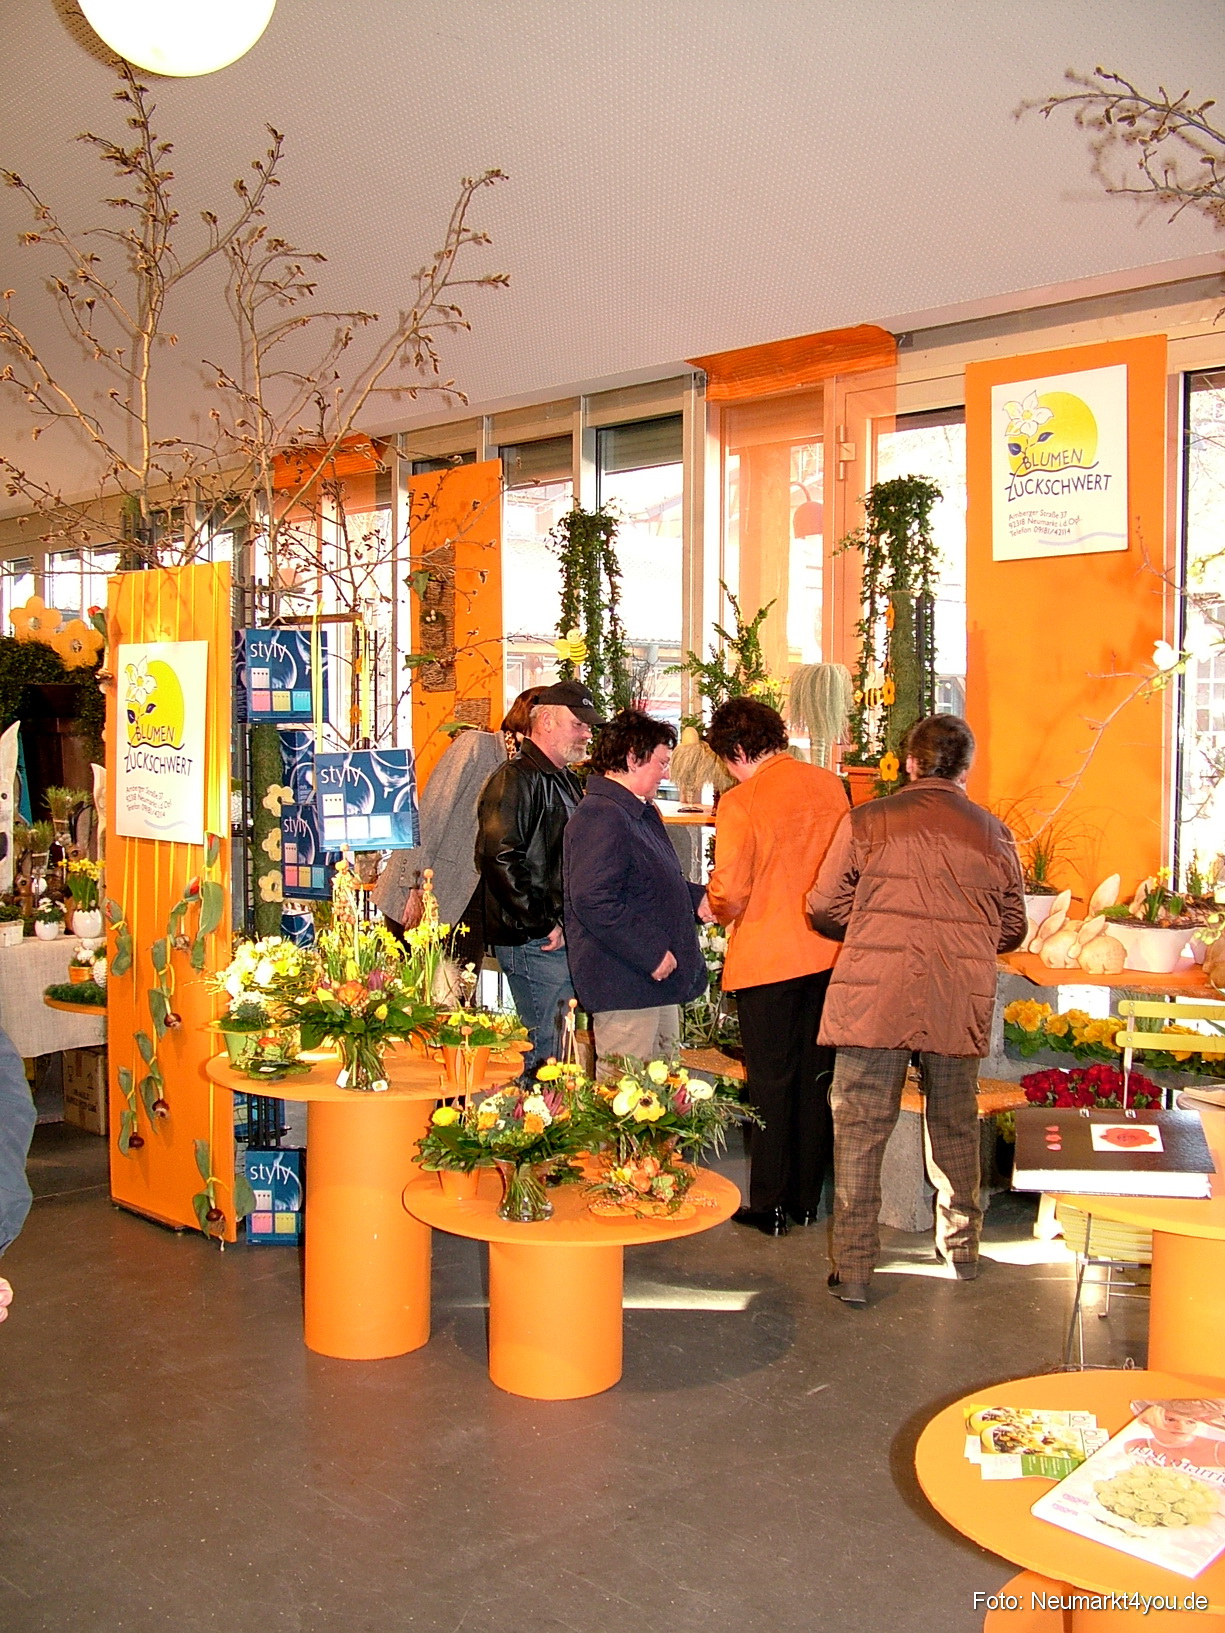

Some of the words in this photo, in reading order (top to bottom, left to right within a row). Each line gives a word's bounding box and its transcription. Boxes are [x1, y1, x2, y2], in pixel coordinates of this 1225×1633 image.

[1022, 448, 1083, 470] BLUMEN
[1004, 473, 1112, 502] ZUCKSCHWERT
[1008, 510, 1039, 520] Amberger
[1040, 509, 1060, 519] Straße
[1027, 517, 1057, 528] Neumarkt
[1009, 527, 1032, 537] Telefon
[135, 723, 175, 742] BLUMEN
[124, 745, 193, 776] ZUCKSCHWERT
